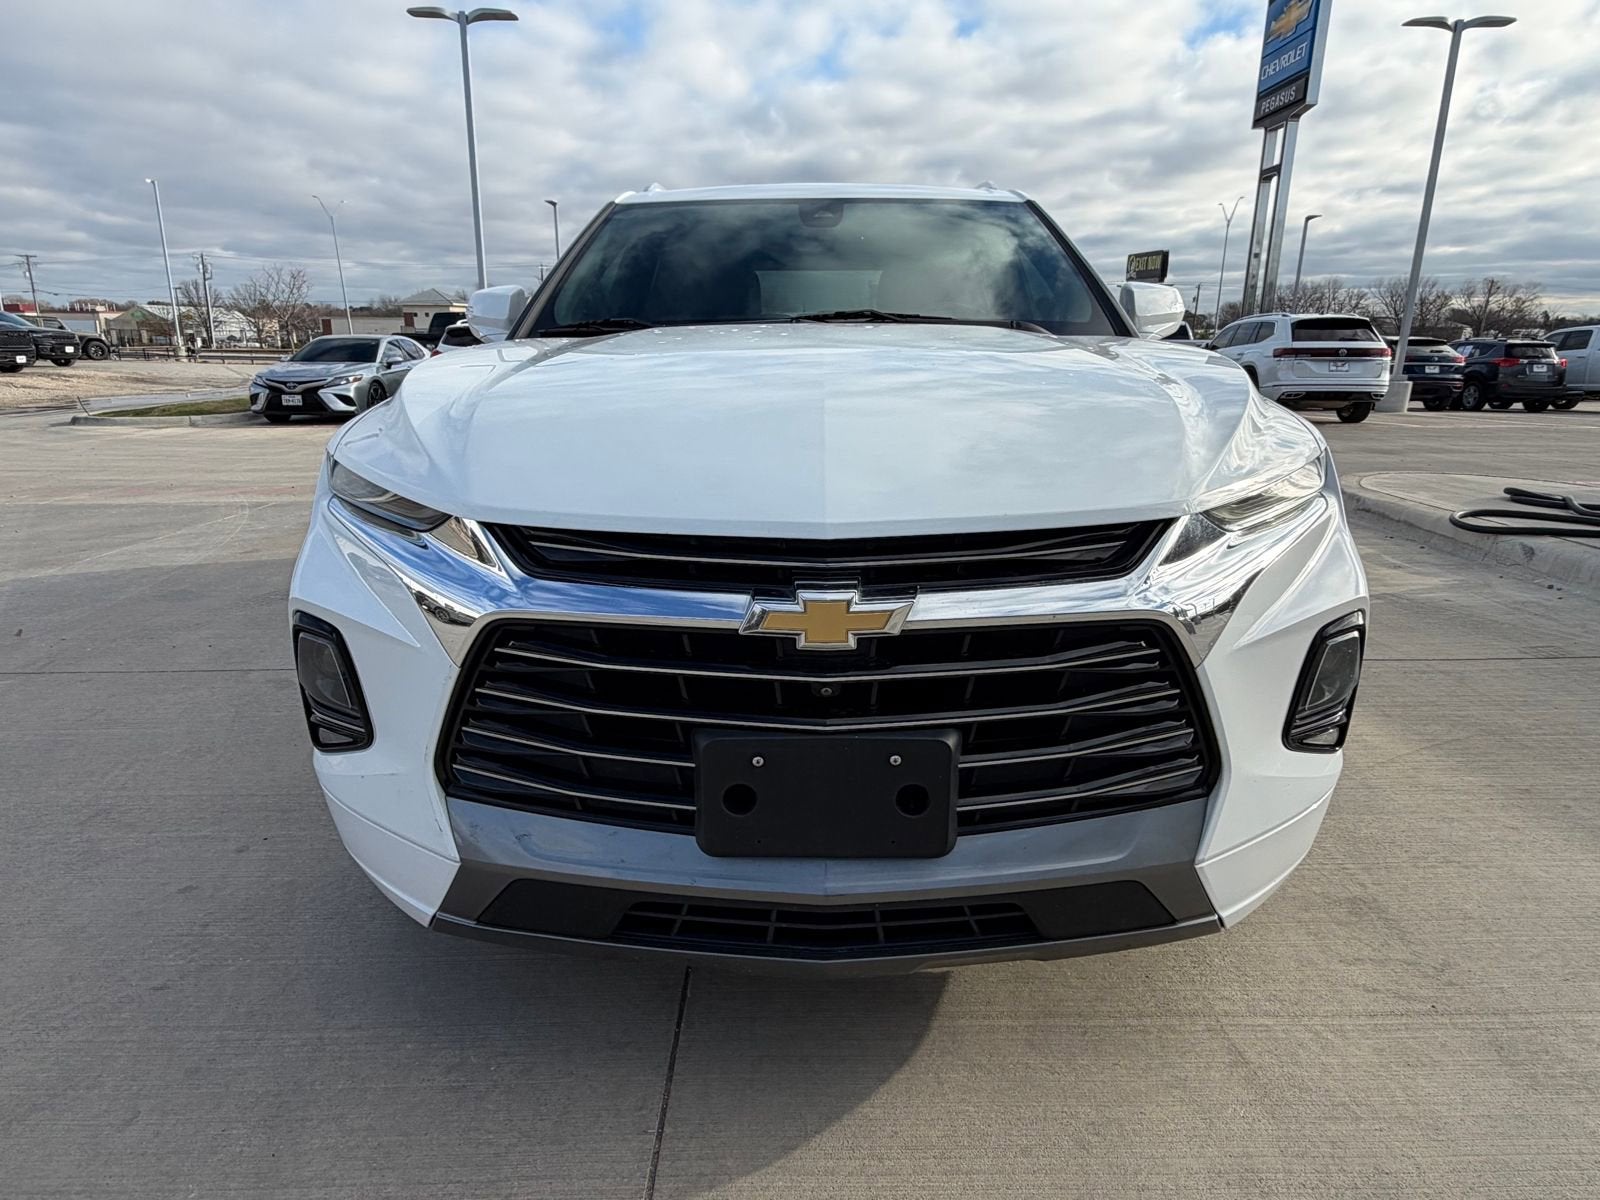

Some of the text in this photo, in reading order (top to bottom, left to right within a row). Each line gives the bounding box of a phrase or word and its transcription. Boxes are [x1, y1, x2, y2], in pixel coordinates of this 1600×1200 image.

[1261, 42, 1308, 80] CHEVROLET
[1261, 86, 1296, 114] PEGASUS
[1135, 256, 1147, 271] EXIT
